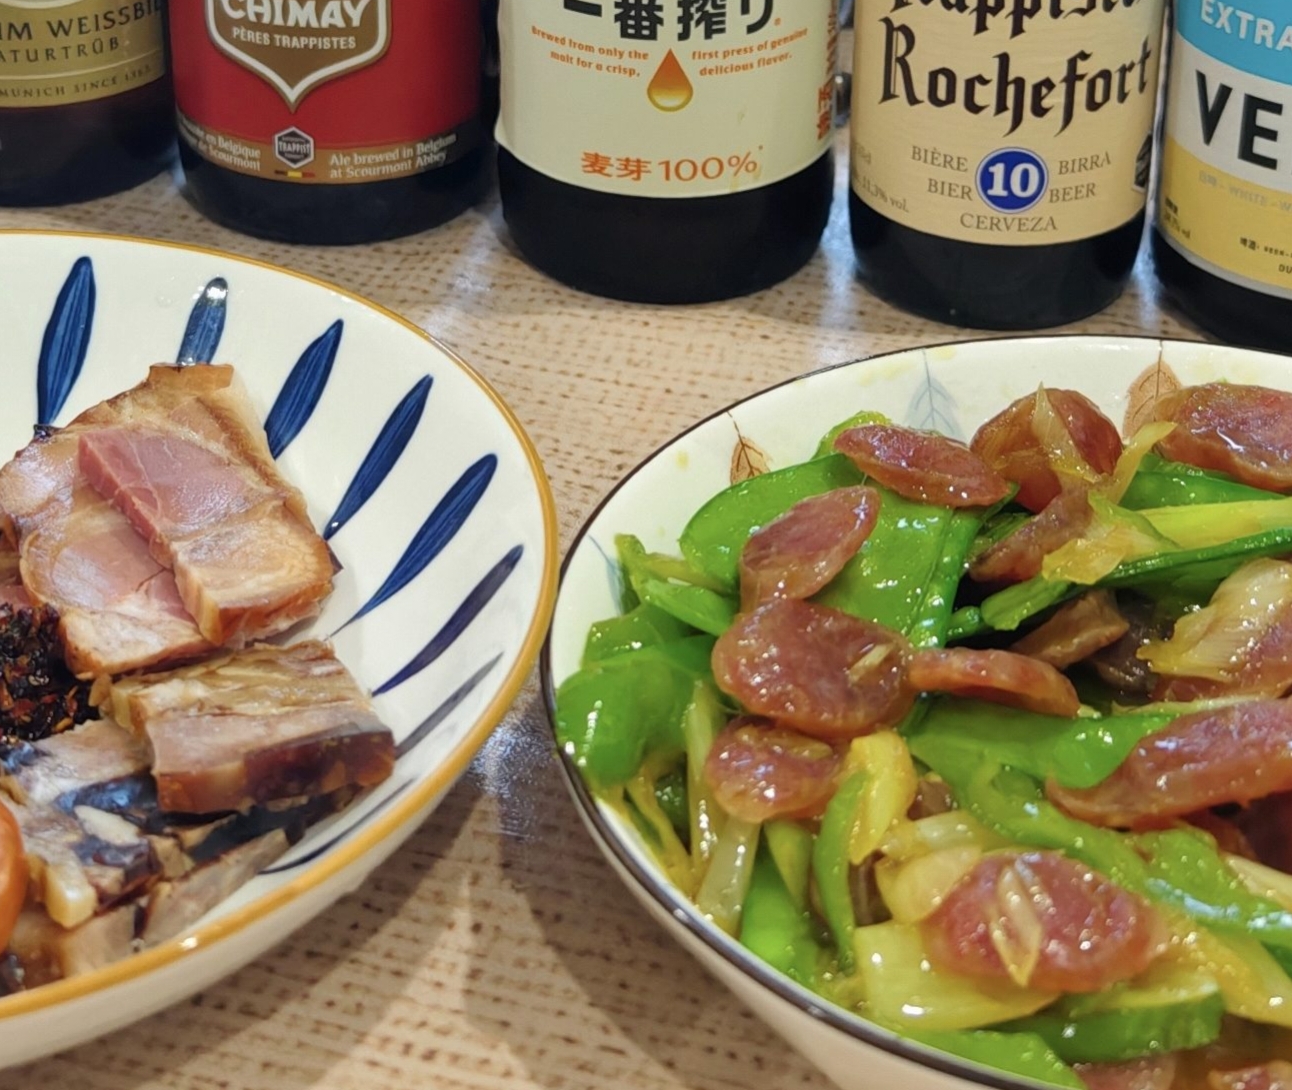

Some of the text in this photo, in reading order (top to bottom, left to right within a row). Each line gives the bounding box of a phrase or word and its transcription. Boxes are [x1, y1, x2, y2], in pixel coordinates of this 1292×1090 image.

[232, 25, 357, 50] PÈRES TRAPPISTES
[568, 38, 595, 53] from
[597, 46, 625, 60] only
[627, 49, 650, 61] the
[691, 50, 719, 61] first
[722, 44, 755, 60] press
[756, 40, 769, 52] of
[576, 56, 593, 69] for
[595, 63, 604, 72] a
[699, 61, 755, 77] delicious
[74, 75, 118, 93] SINCE
[877, 16, 1152, 138] Rochefort
[218, 135, 261, 160] Belgique
[279, 141, 310, 155] TRAPPIST
[330, 153, 351, 167] Ale
[353, 149, 400, 166] brewed
[402, 147, 414, 159] in
[330, 167, 343, 179] at
[346, 159, 413, 178] Scourmont
[911, 145, 1112, 198] BIÈRE 10 BIRRA
[927, 177, 1097, 204] BIER BEER
[960, 212, 1058, 233] CERVEZA
